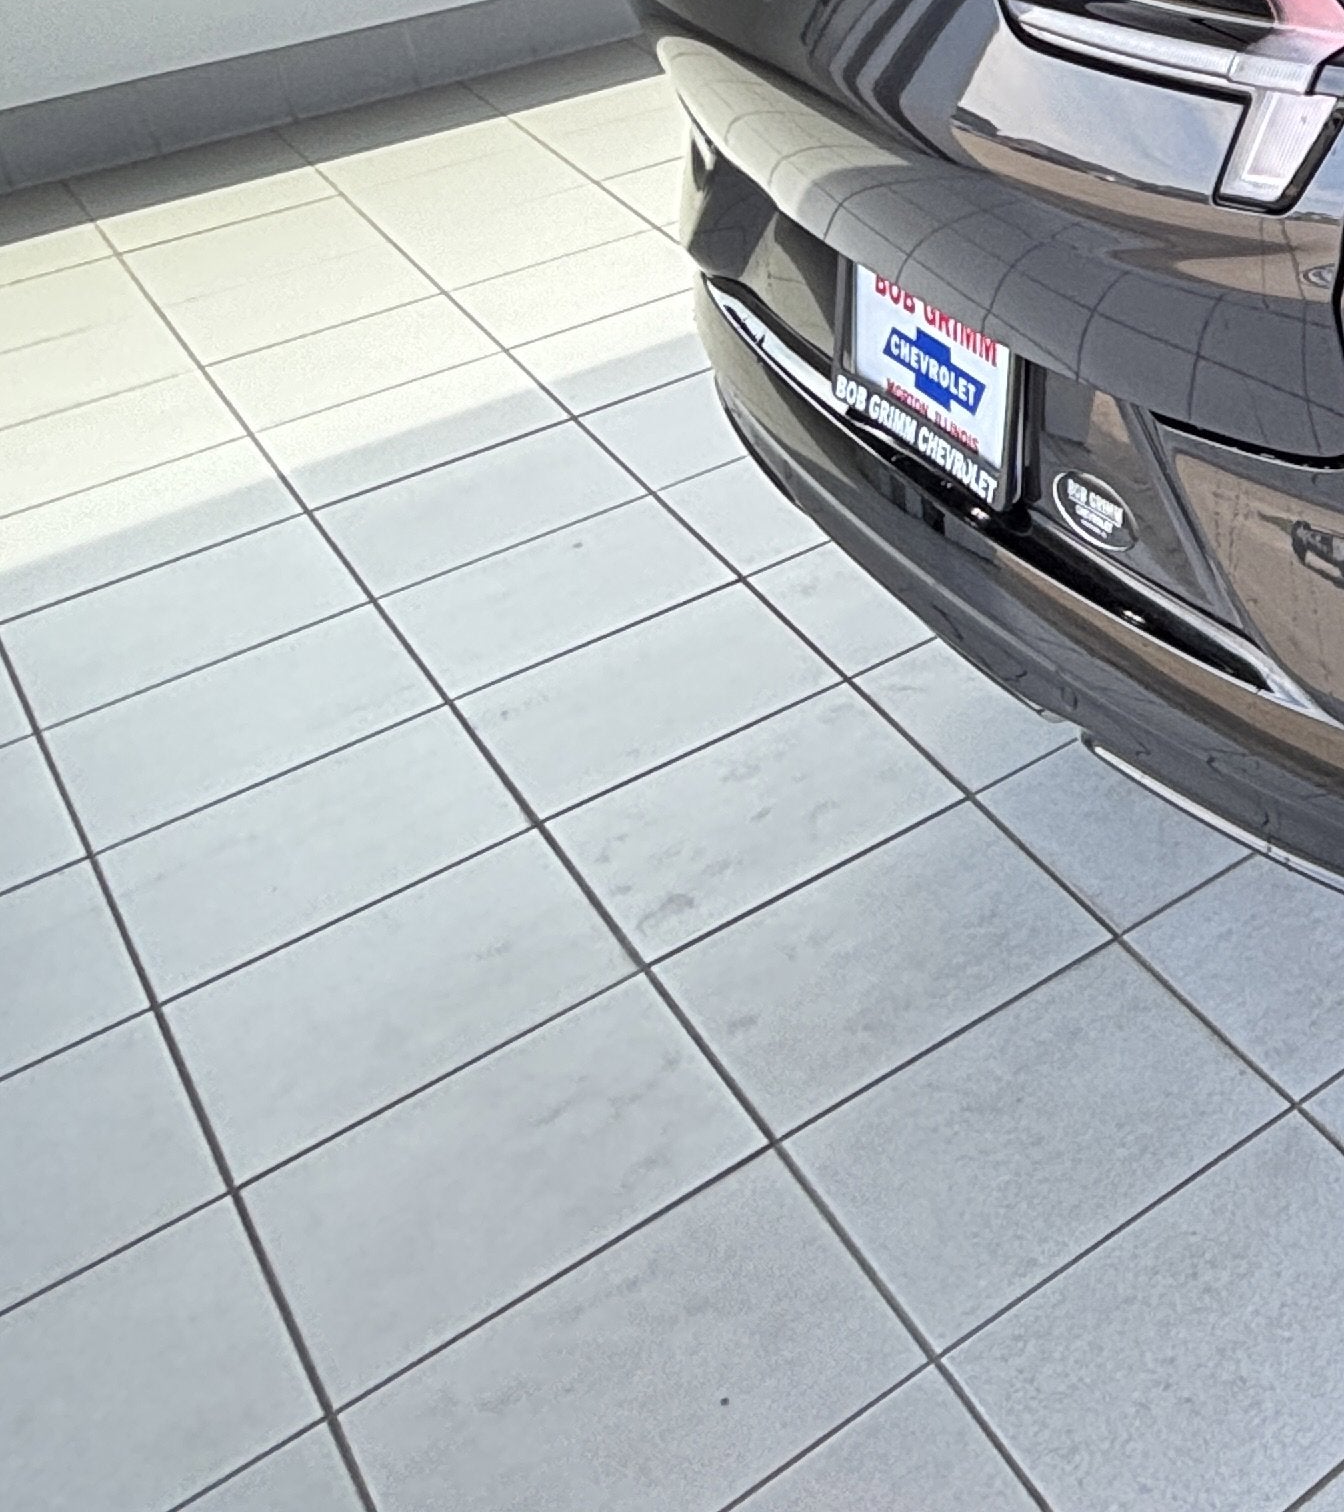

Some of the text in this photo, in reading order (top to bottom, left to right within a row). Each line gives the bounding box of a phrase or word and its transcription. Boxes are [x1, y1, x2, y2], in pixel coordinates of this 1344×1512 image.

[875, 274, 916, 314] BOB
[890, 334, 976, 407] CHEVROLET
[836, 374, 998, 504] BOB GRIMM CHEVROLET
